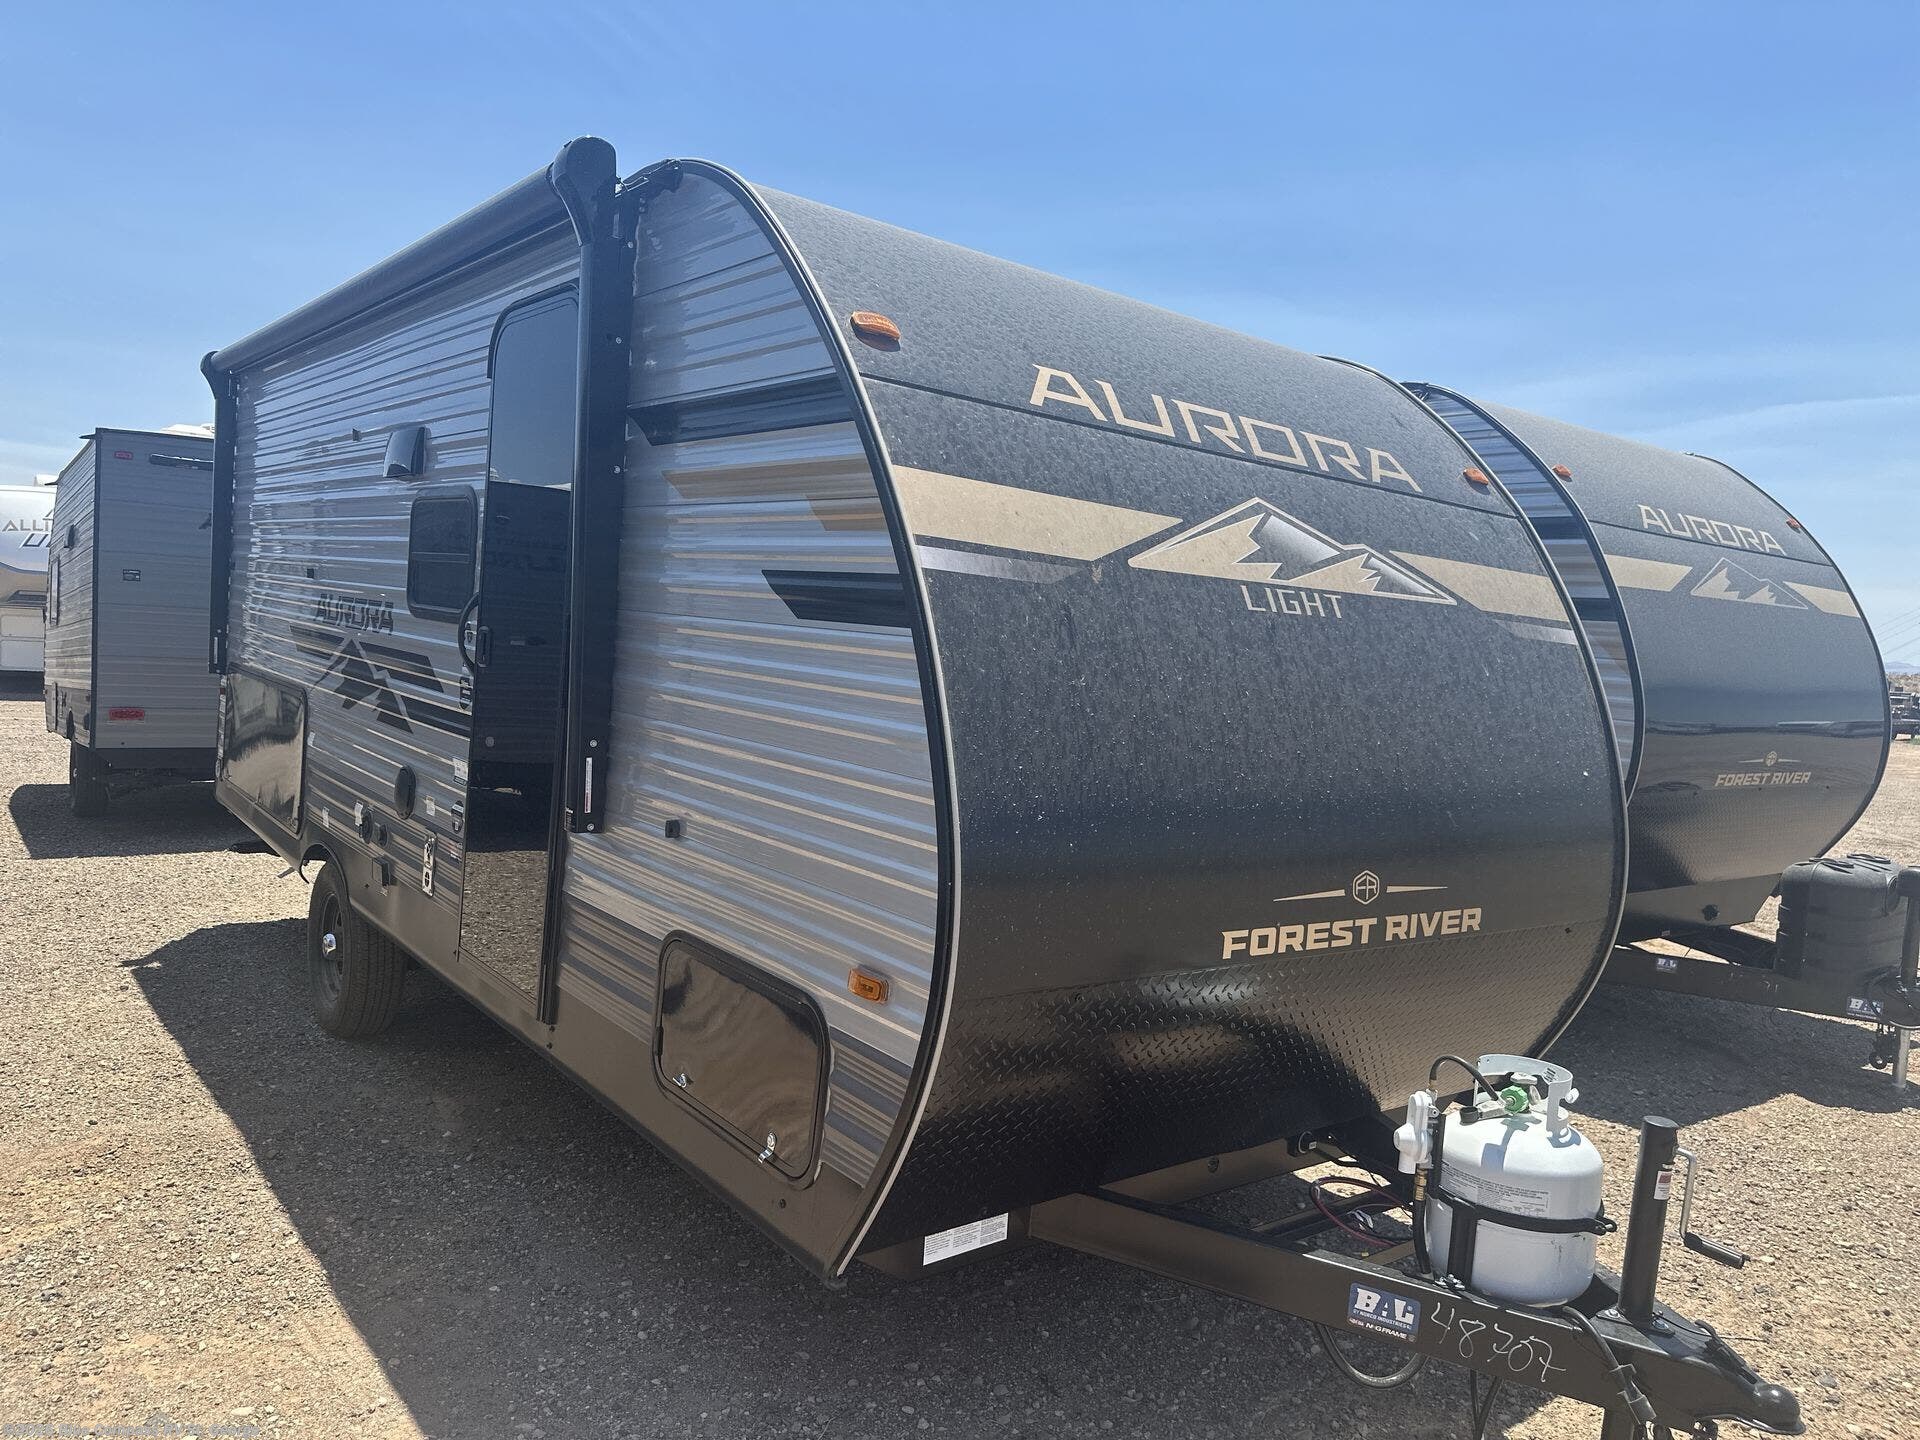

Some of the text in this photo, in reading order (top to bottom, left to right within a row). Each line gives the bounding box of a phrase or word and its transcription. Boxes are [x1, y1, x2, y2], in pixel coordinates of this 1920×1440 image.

[1030, 364, 1423, 493] AURORA
[2, 519, 50, 532] ALLI
[1637, 504, 1787, 556] AURORA
[313, 593, 394, 635] AURORA
[1240, 585, 1342, 619] LIGHT
[1714, 771, 1812, 787] FOREST RIVER
[1222, 907, 1482, 960] FOREST RIVER
